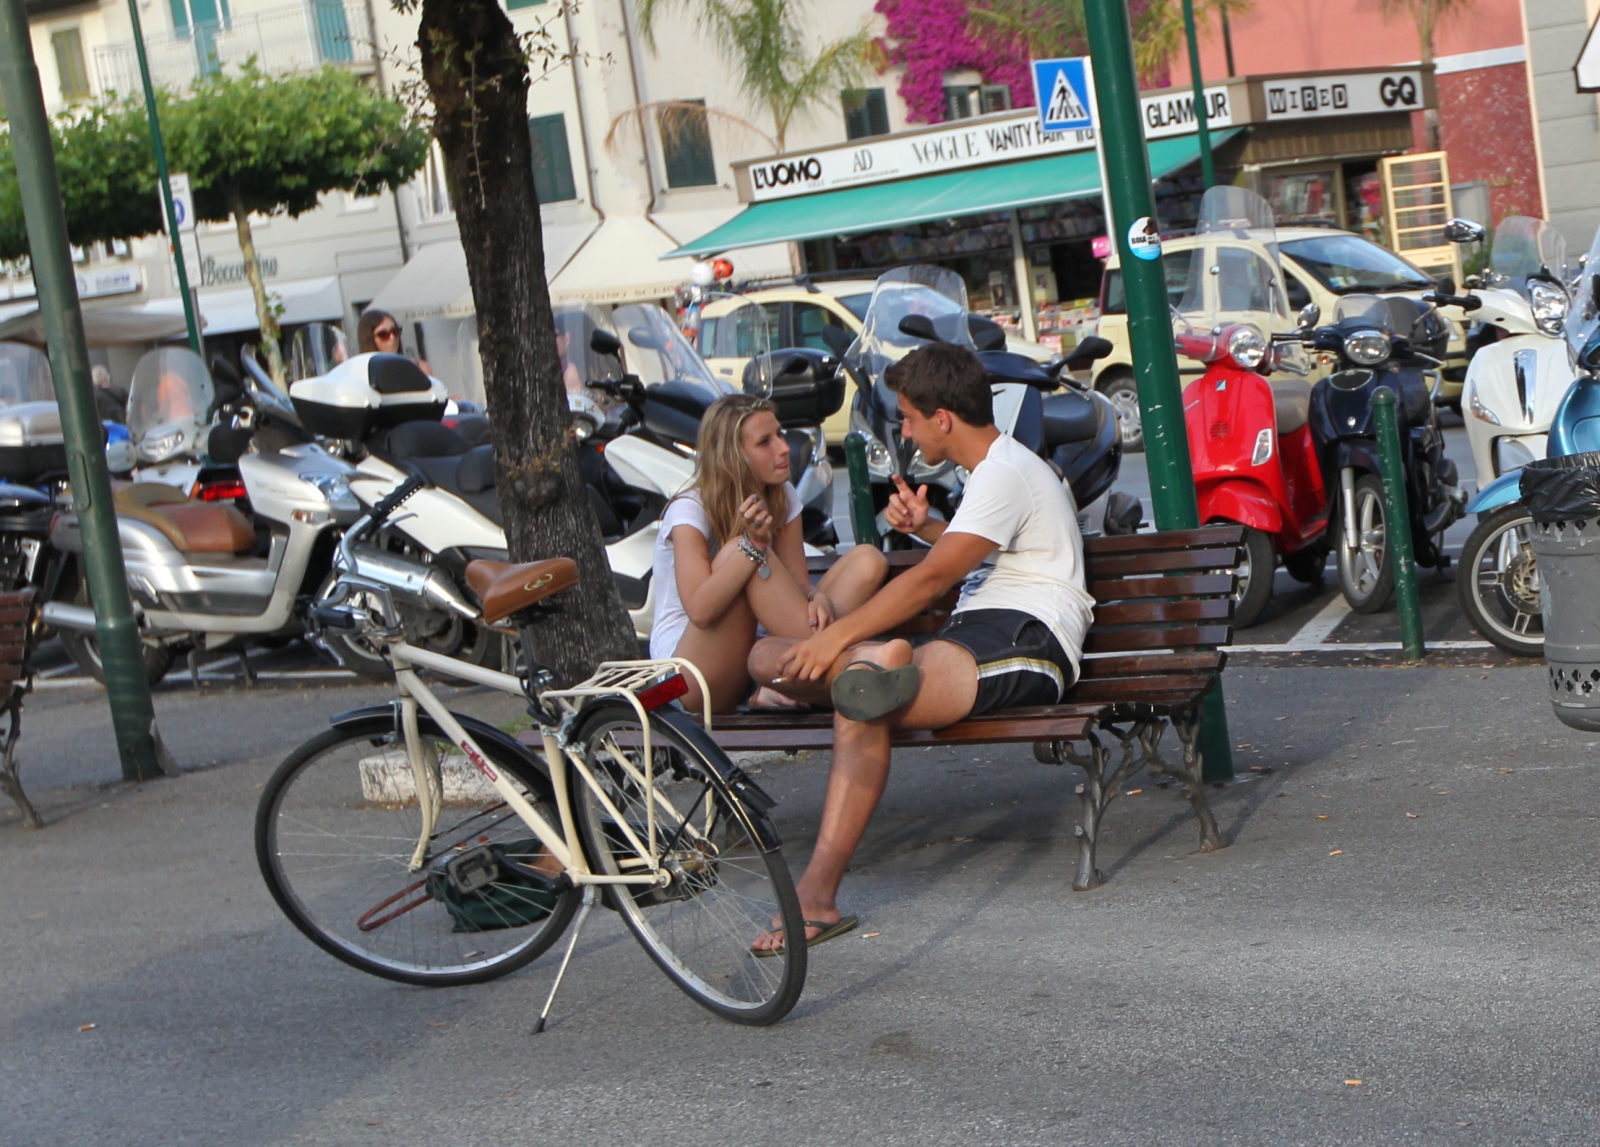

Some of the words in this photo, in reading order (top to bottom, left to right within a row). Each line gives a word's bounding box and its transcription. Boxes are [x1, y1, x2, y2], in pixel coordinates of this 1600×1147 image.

[1269, 84, 1348, 114] WIRED
[1379, 75, 1418, 107] GQ
[1146, 92, 1229, 129] GLAMUR
[912, 131, 980, 165] VOGUE
[986, 122, 1032, 152] VANITY
[752, 157, 822, 190] L'UOMO
[853, 148, 873, 173] AD
